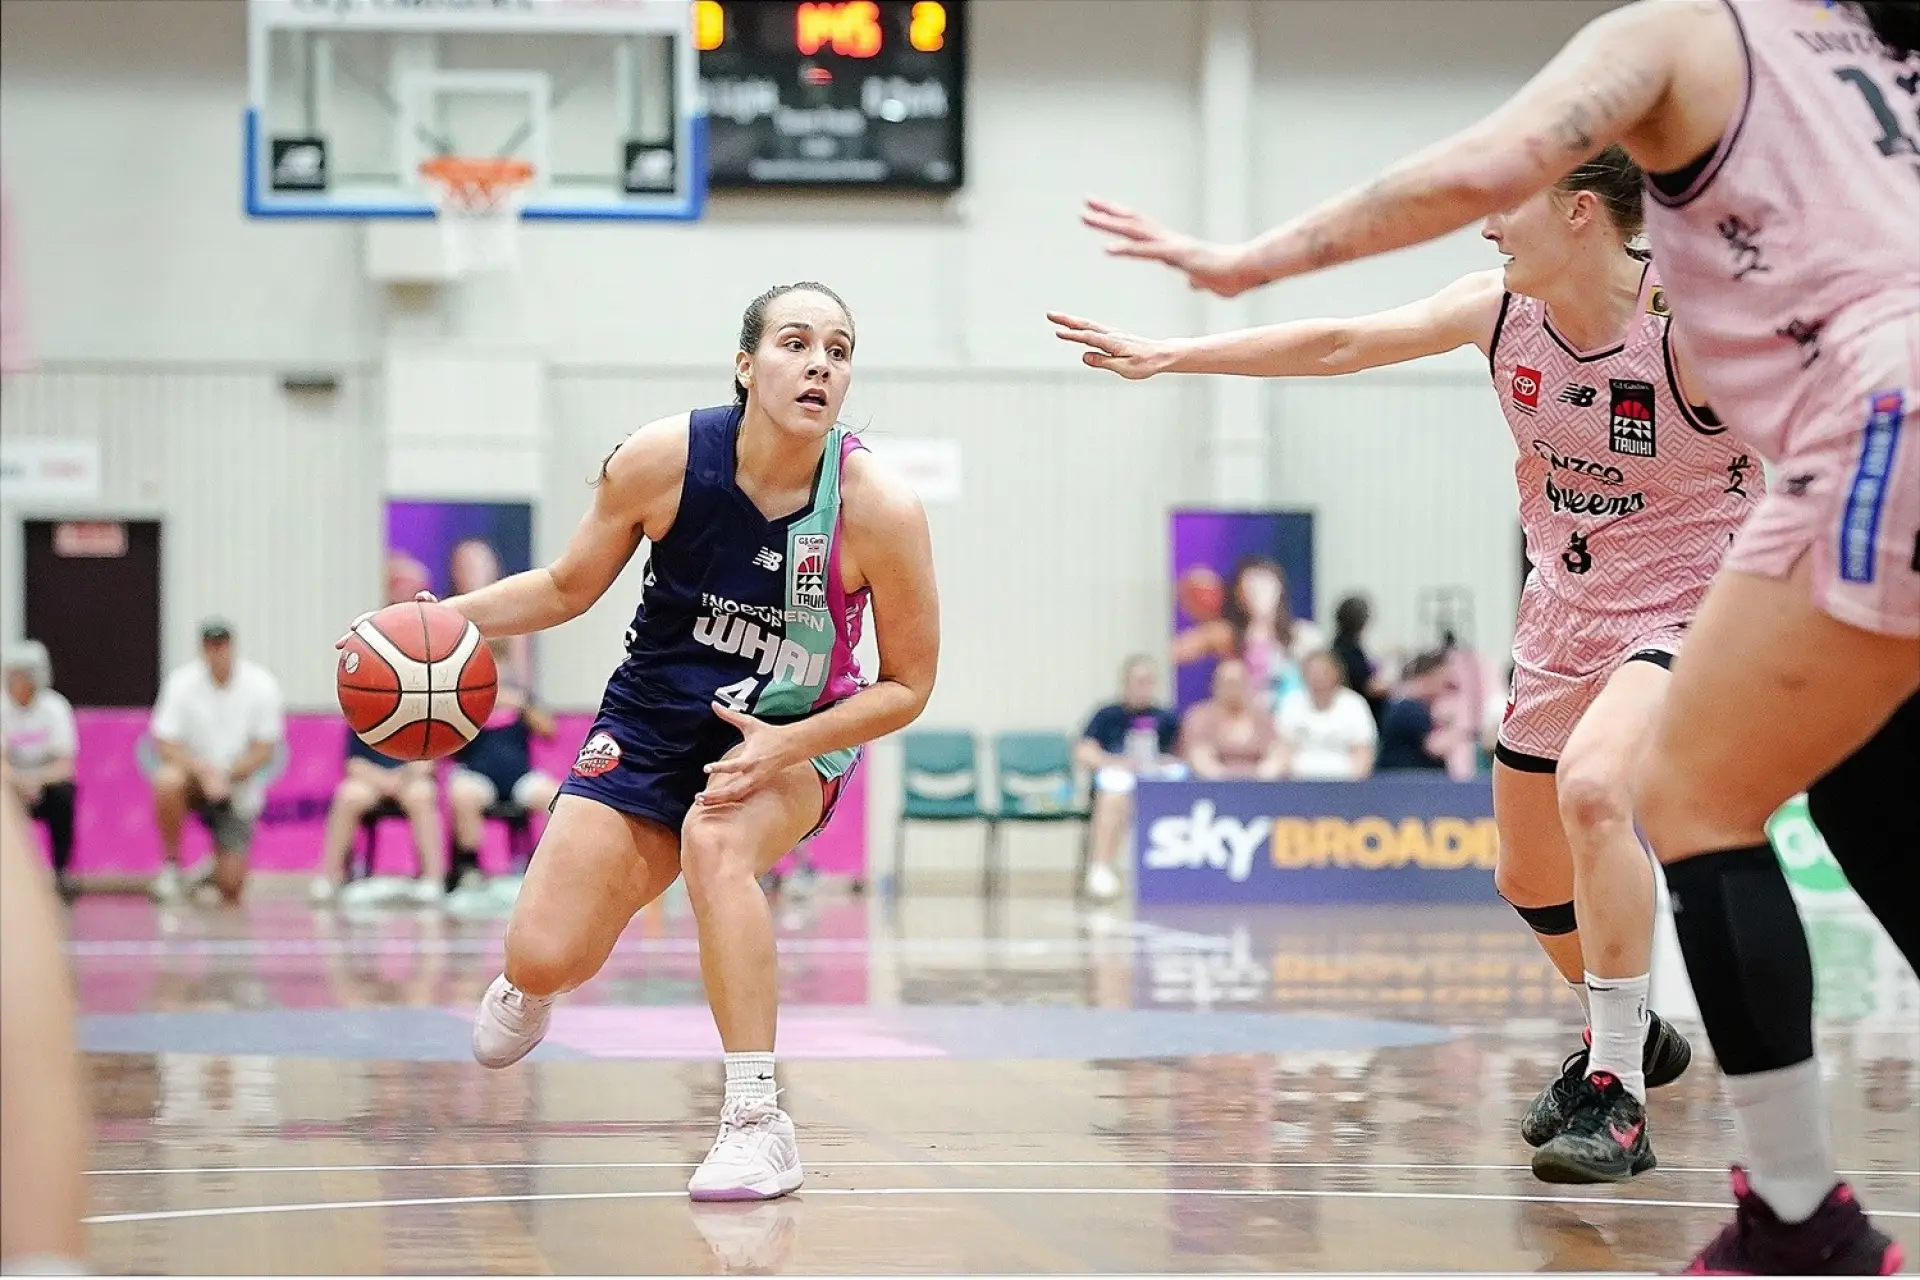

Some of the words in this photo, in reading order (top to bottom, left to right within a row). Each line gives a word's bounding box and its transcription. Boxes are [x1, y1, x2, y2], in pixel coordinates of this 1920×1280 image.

[1545, 472, 1645, 515] Queens
[692, 614, 826, 687] WHAI
[714, 676, 759, 712] 4
[1145, 799, 1270, 882] sky
